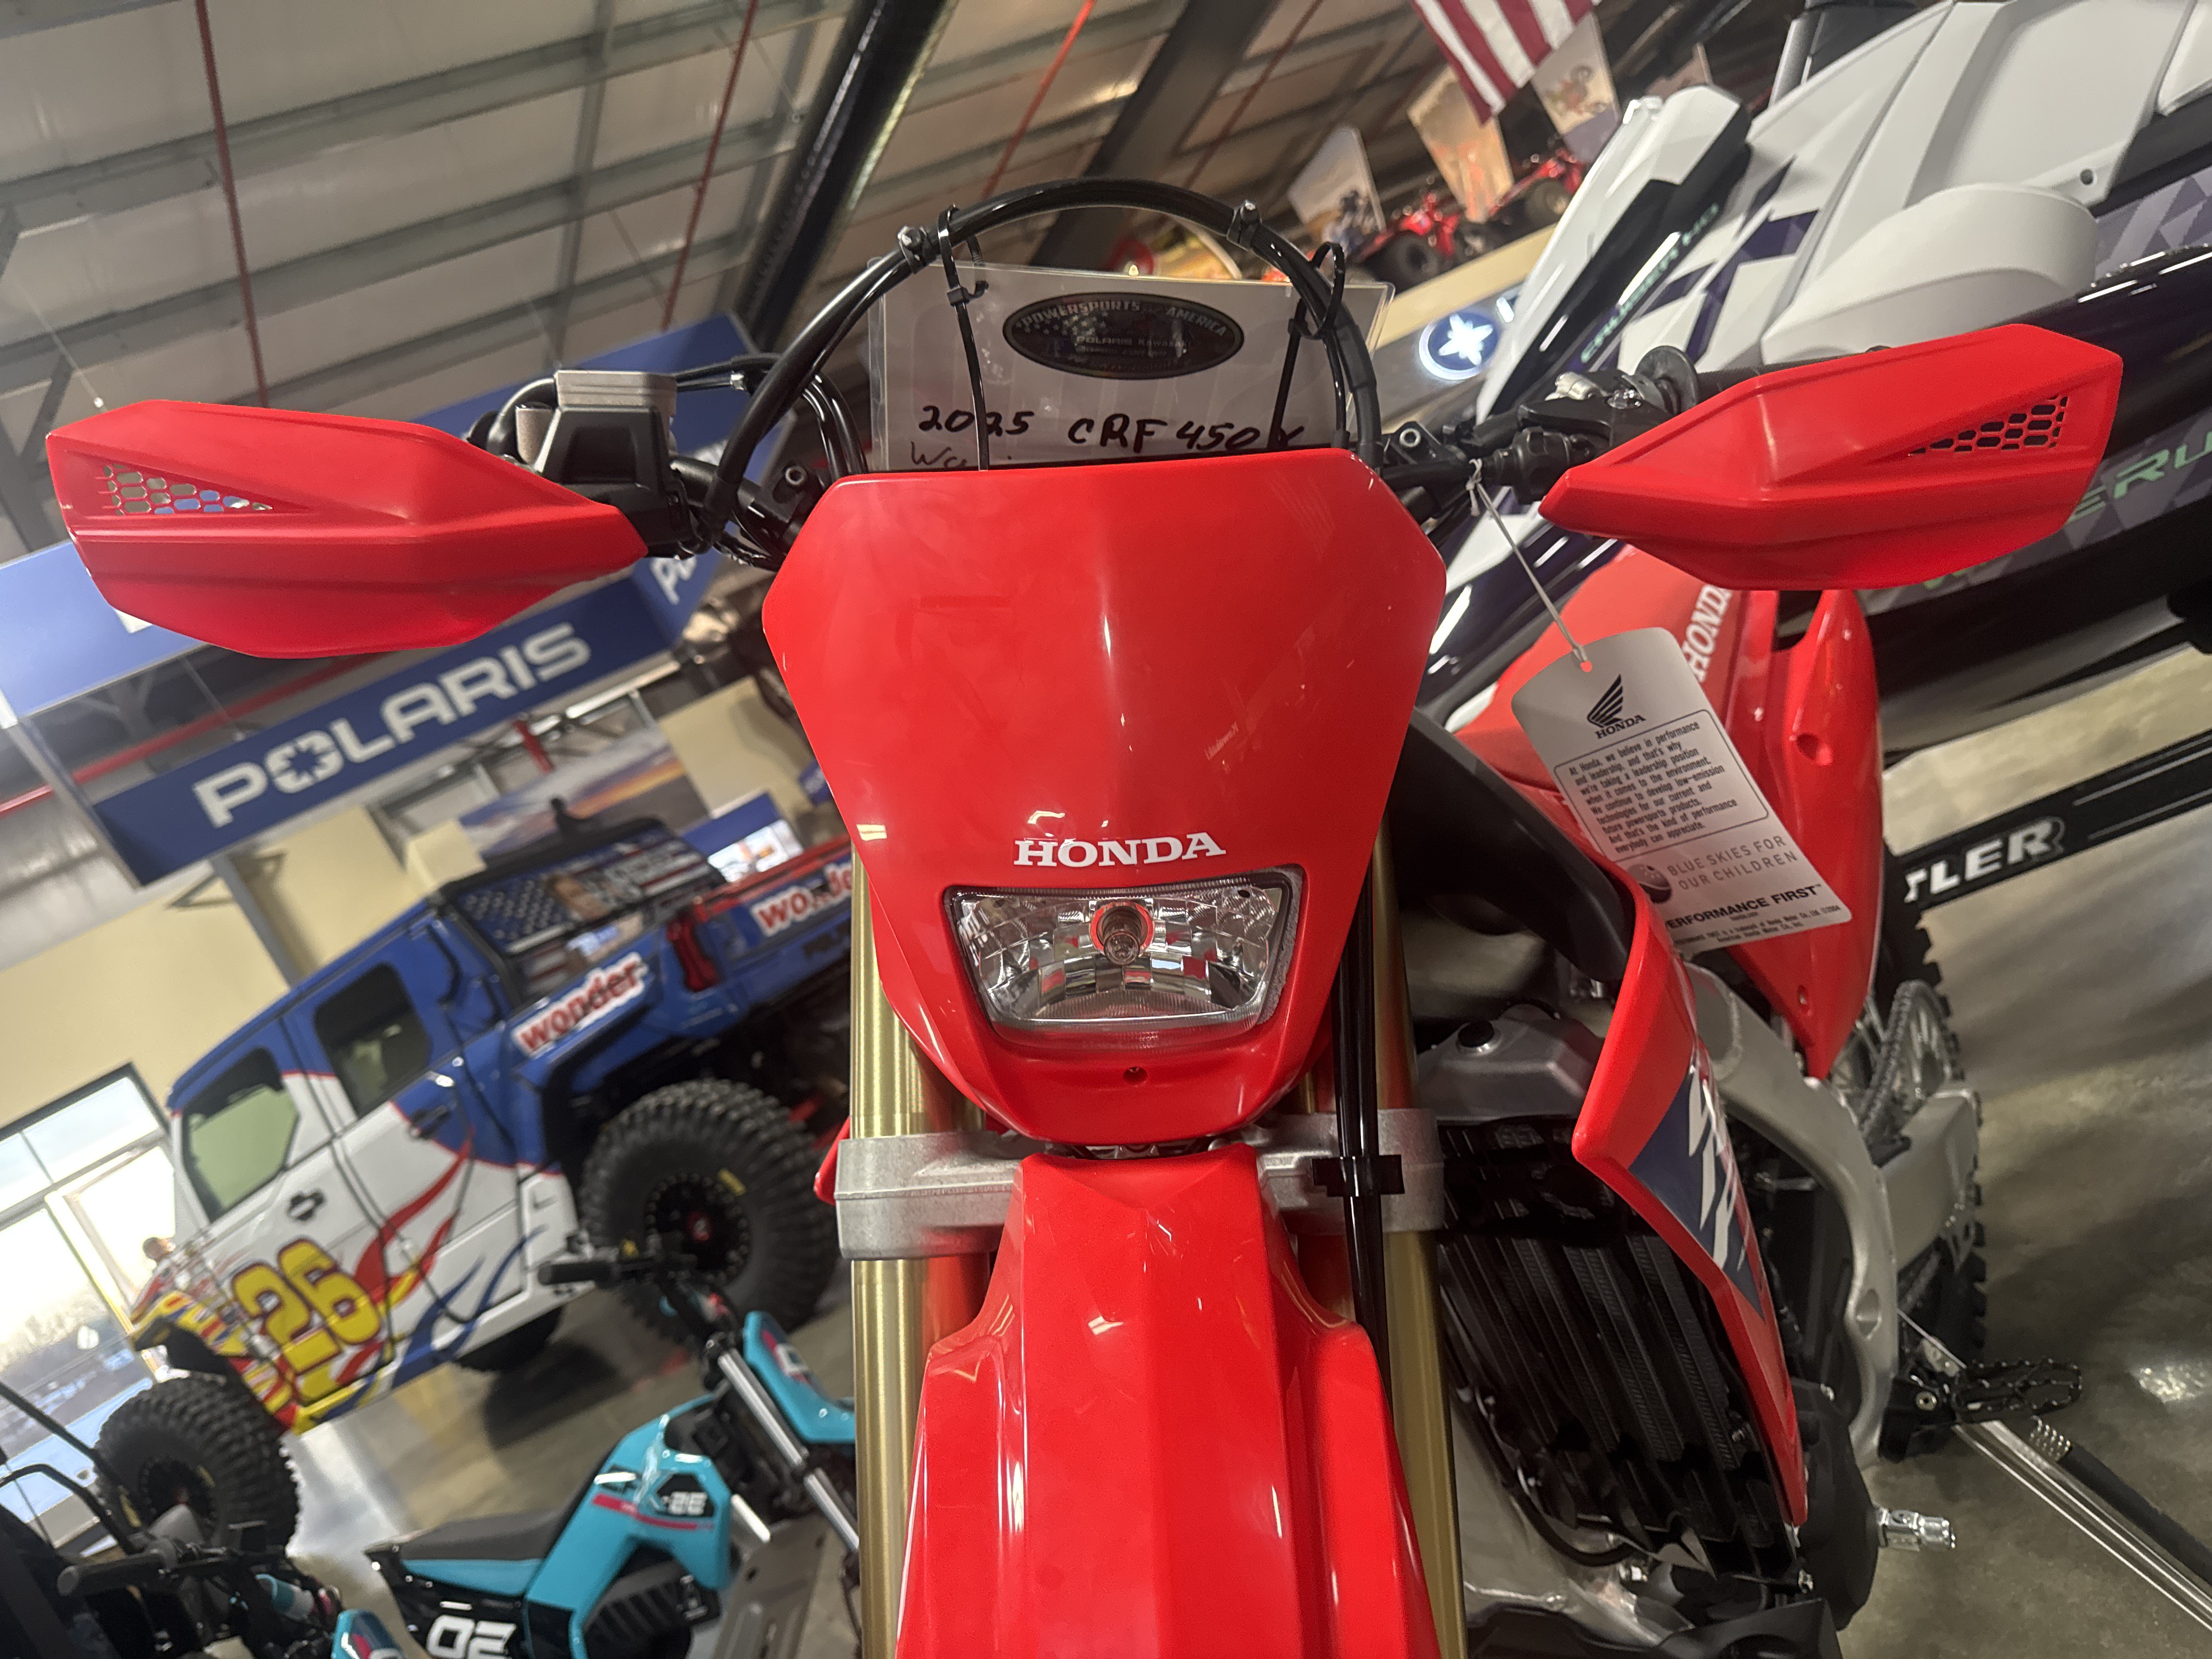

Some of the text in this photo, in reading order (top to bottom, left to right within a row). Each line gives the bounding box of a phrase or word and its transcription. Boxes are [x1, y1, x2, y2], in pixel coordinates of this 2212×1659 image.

[1021, 300, 1141, 326] POWERSPORTS
[1165, 306, 1228, 337] AMERICA
[1076, 336, 1132, 346] POLARIS
[918, 405, 1035, 436] 2025
[1068, 413, 1168, 454] CRF
[1681, 584, 1734, 684] HOND
[193, 622, 591, 828] POLARIS
[1595, 714, 1646, 739] HONDA
[1568, 721, 1700, 776] At Honda, we believe in performance
[1575, 775, 1587, 786] and
[1627, 756, 1640, 767] and
[1643, 747, 1664, 760] that's
[1667, 741, 1682, 752] why
[1580, 785, 1598, 795] we're
[1600, 775, 1622, 788] taking
[1632, 760, 1667, 777] leadership
[1671, 747, 1699, 764] position
[1585, 794, 1603, 805] when
[1606, 789, 1611, 798] it
[1615, 783, 1636, 796] comes
[1650, 774, 1662, 783] the
[1590, 764, 1725, 815] We continue to develop low-emission
[1596, 780, 1712, 825] technologies for our current and
[1602, 798, 1702, 834] future powersports products.
[1609, 798, 1737, 844] And that's the kind of performance
[1013, 831, 1227, 868] HONDA
[1615, 839, 1648, 854] everybody
[1650, 834, 1664, 843] can
[1667, 835, 1786, 876] BLUE SKIES FOR
[1678, 850, 1798, 890] OUR CHILDREN
[1665, 898, 1770, 929] ERFORMANCE
[518, 959, 642, 1050] wonder
[231, 1233, 382, 1375] 26
